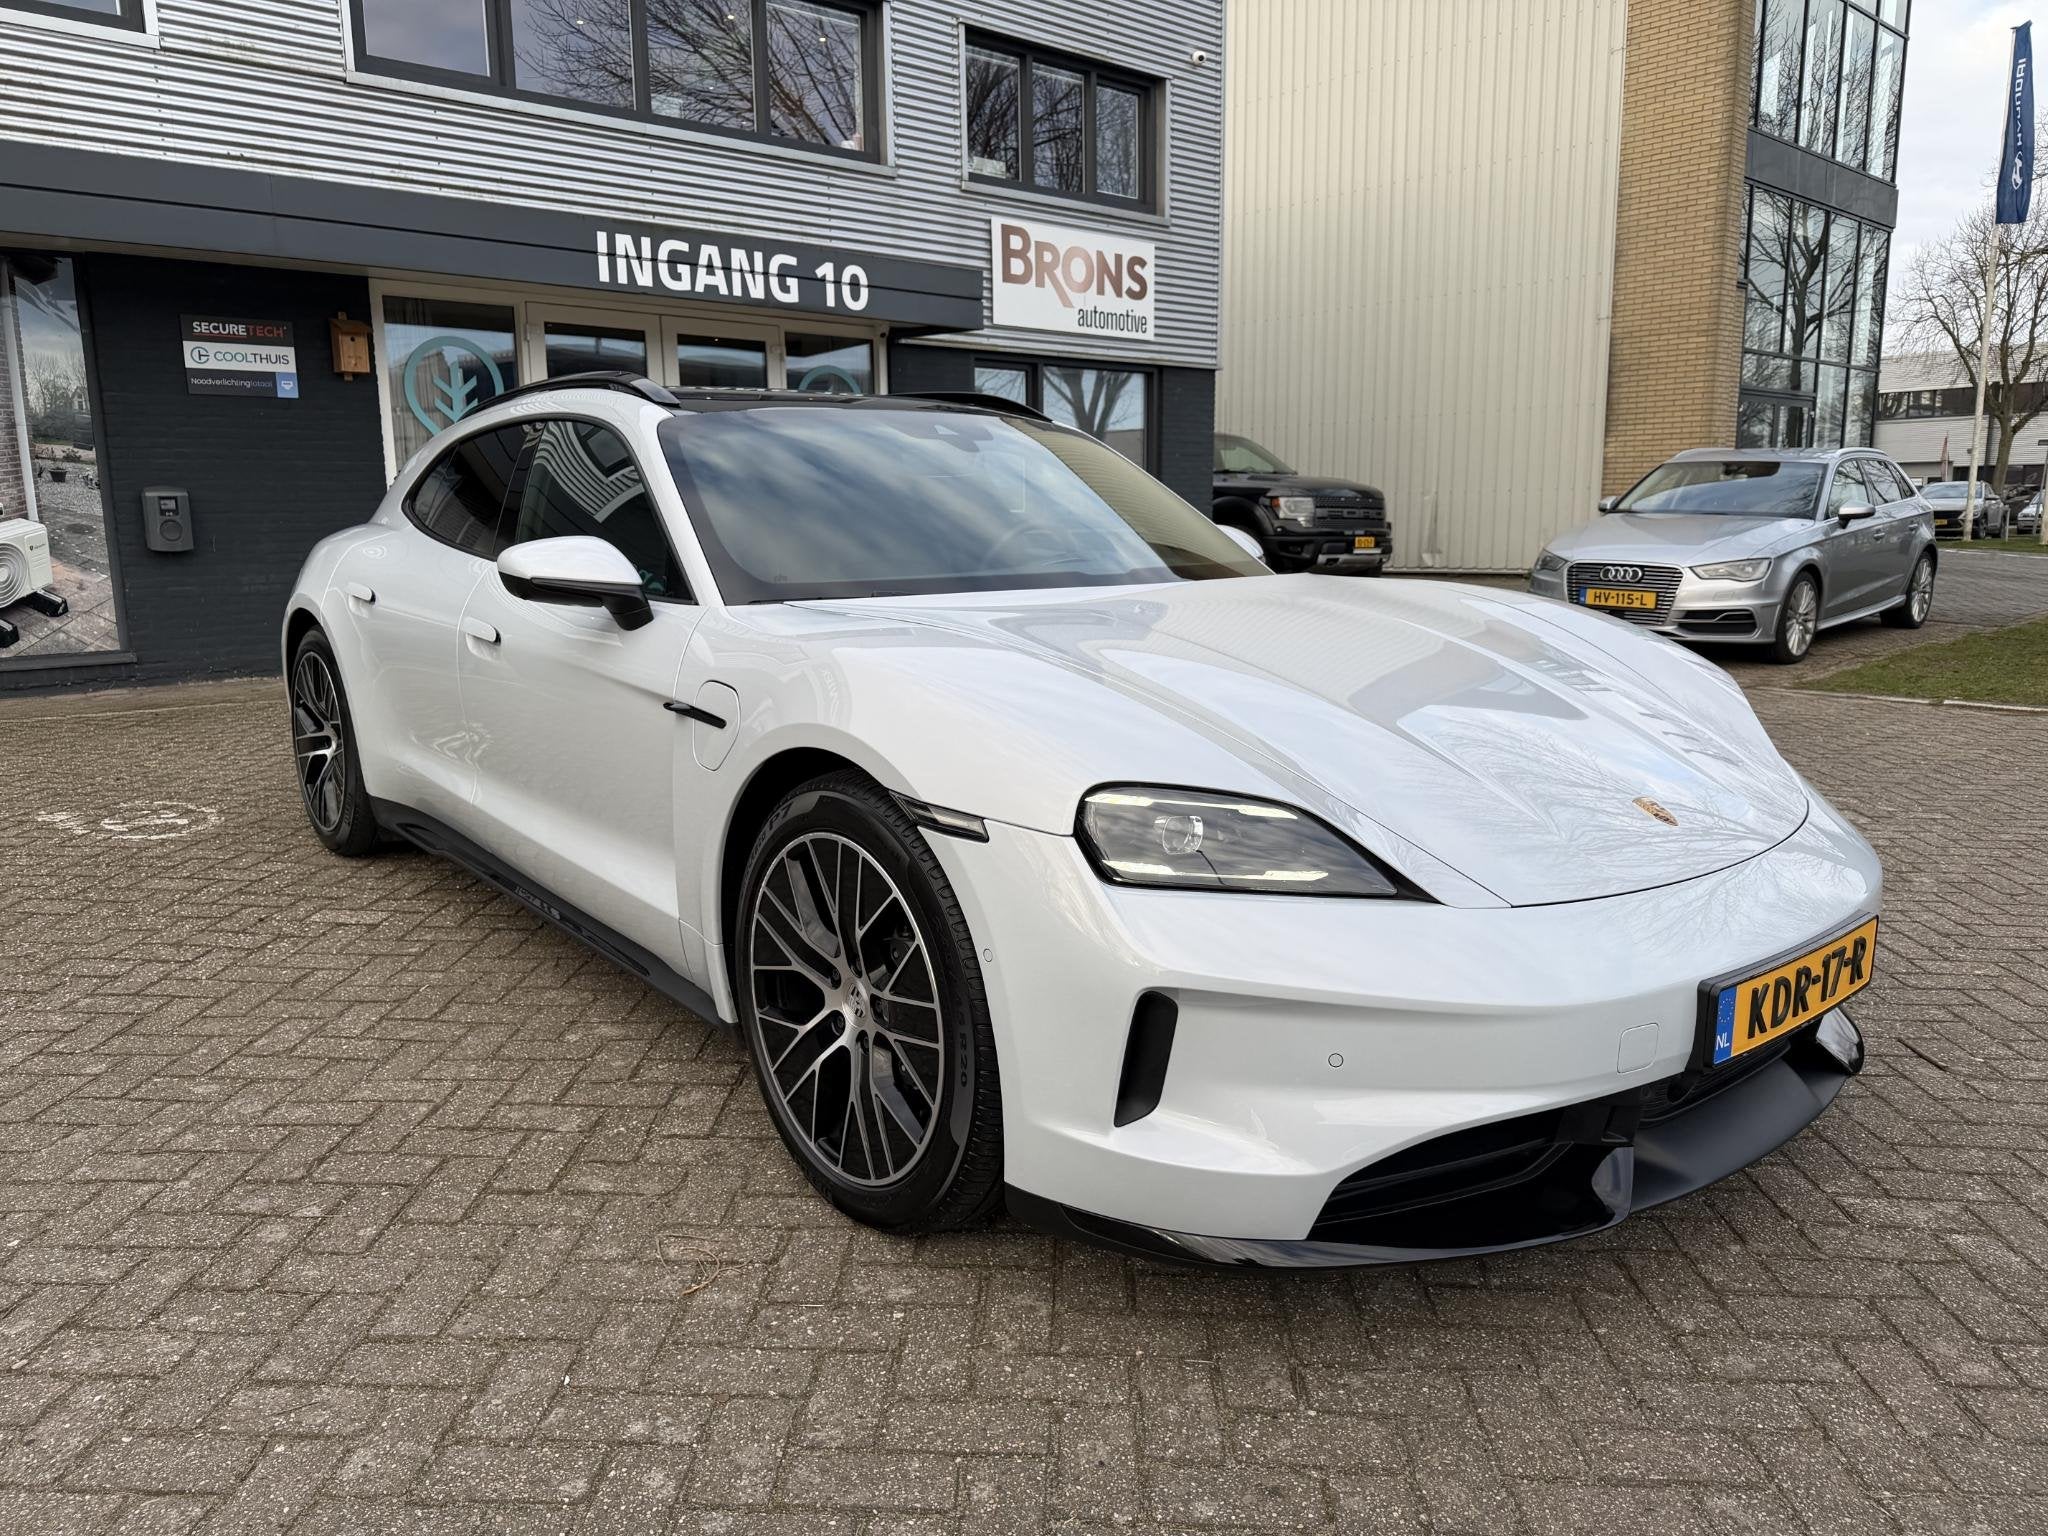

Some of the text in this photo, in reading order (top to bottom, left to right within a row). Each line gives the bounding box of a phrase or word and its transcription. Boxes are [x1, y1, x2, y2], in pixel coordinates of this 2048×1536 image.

[2014, 58, 2027, 146] HYUNDAI
[596, 230, 869, 311] INGANG 10
[192, 321, 284, 338] SECURETECH
[1077, 305, 1148, 334] automotive
[213, 350, 290, 365] COOLTHUIS
[1593, 591, 1648, 606] HV-115-L
[1747, 935, 1867, 1040] KDR-17-R
[1715, 1033, 1730, 1050] NL
